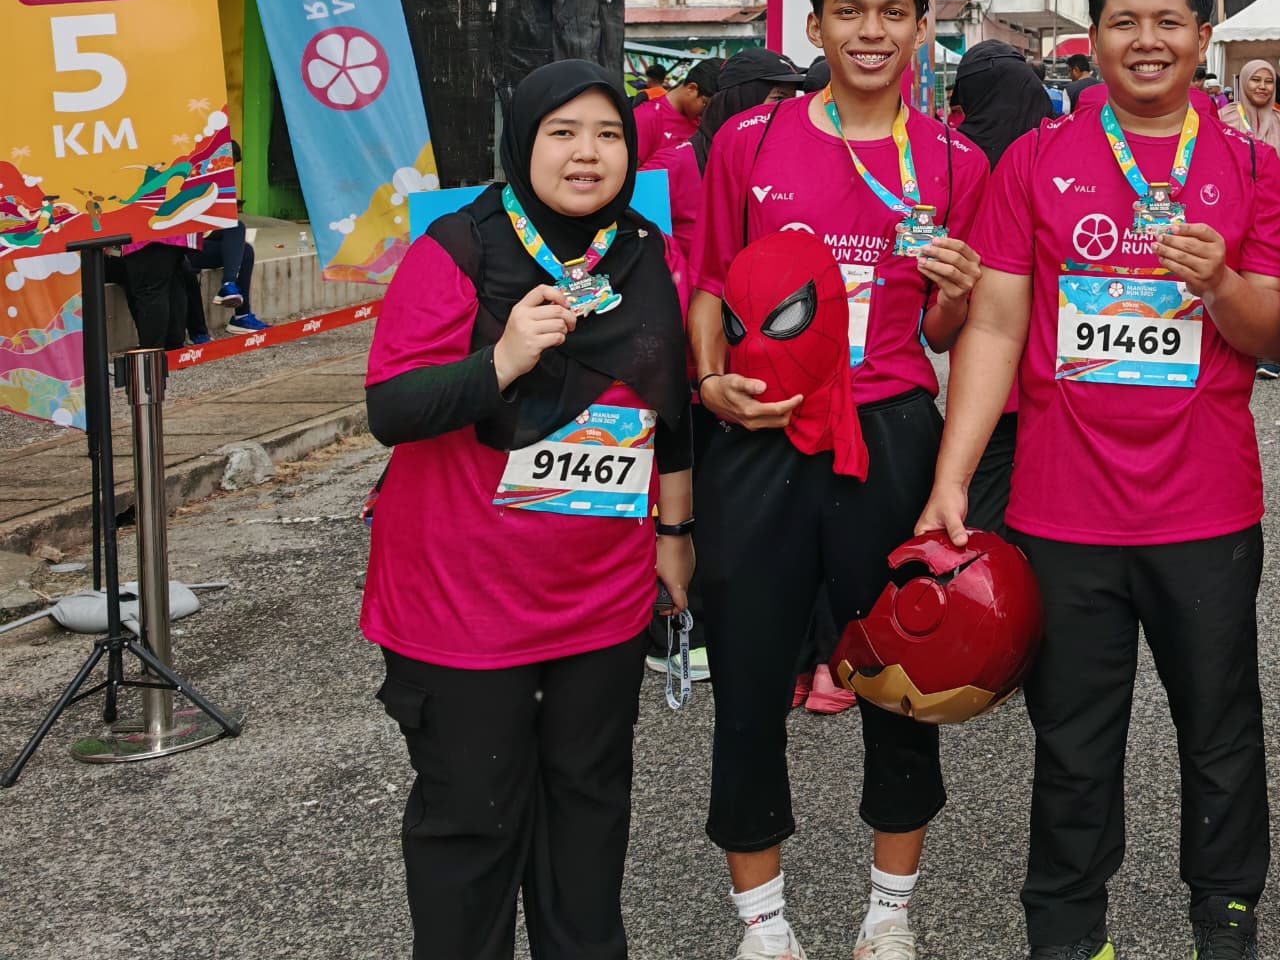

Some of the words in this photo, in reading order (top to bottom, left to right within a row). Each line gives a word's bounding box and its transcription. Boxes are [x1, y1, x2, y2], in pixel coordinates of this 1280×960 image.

[50, 13, 127, 113] 5
[737, 113, 771, 131] JOMRU
[52, 117, 138, 158] KM
[771, 192, 794, 200] VALE
[1074, 185, 1096, 193] VALE
[832, 248, 852, 262] UN
[854, 248, 881, 263] 202
[1076, 322, 1181, 356] 91469
[532, 449, 637, 486] 91467
